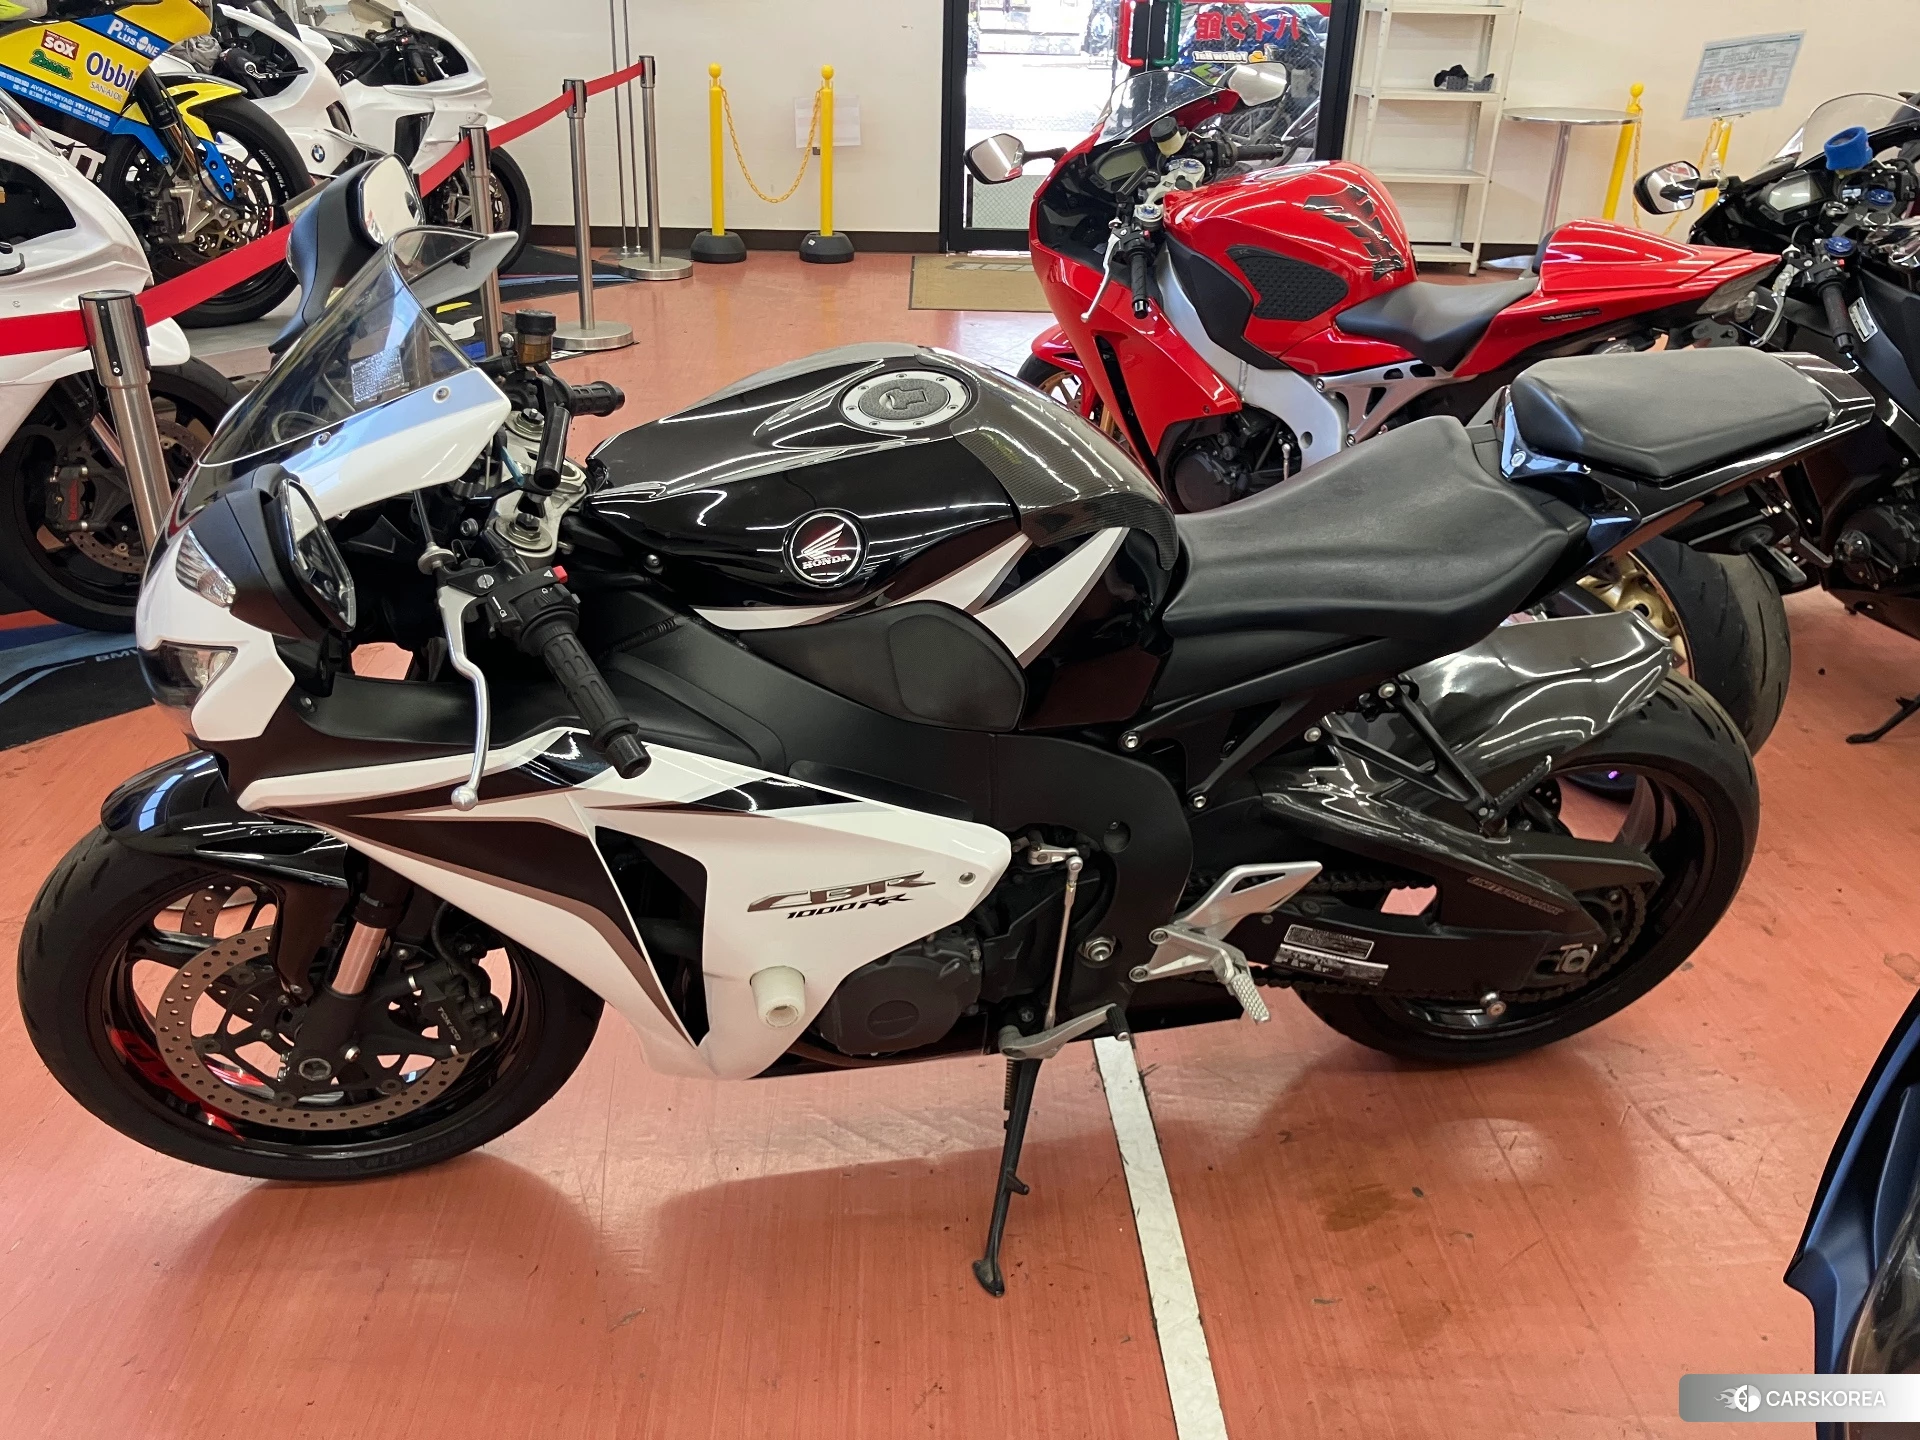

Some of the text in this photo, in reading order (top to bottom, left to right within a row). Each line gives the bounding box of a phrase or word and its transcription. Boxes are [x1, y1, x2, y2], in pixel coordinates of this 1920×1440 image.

[43, 36, 76, 58] SOX
[802, 554, 851, 569] HONDA
[747, 870, 936, 912] CBR
[438, 1006, 461, 1041] TOKICO
